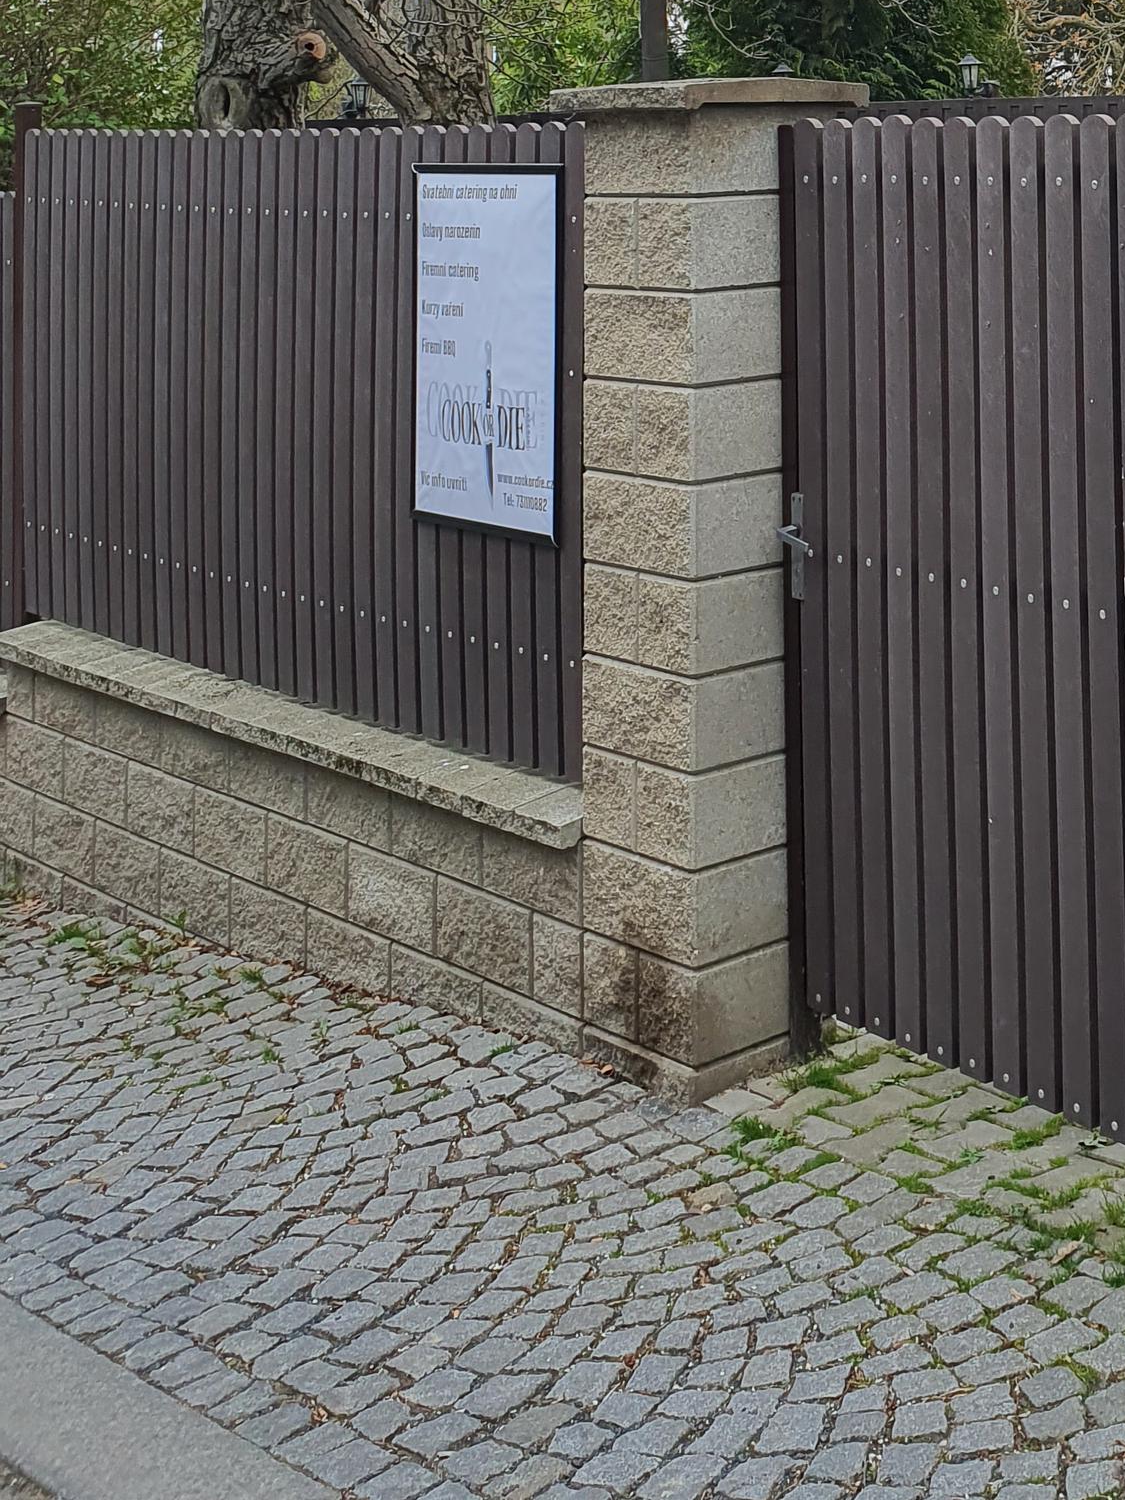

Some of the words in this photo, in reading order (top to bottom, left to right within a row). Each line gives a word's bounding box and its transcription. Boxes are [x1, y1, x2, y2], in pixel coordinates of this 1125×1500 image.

[455, 184, 488, 202] catering
[489, 187, 498, 200] na
[500, 183, 518, 200] ohni
[422, 222, 443, 241] Oslavy
[444, 224, 481, 239] narozenin
[448, 263, 479, 282] catering
[422, 299, 440, 319] Kurzy
[443, 340, 456, 358] BBQ
[441, 399, 482, 446] COOK
[483, 413, 495, 438] OR
[497, 405, 526, 451] DIE
[431, 472, 446, 488] info
